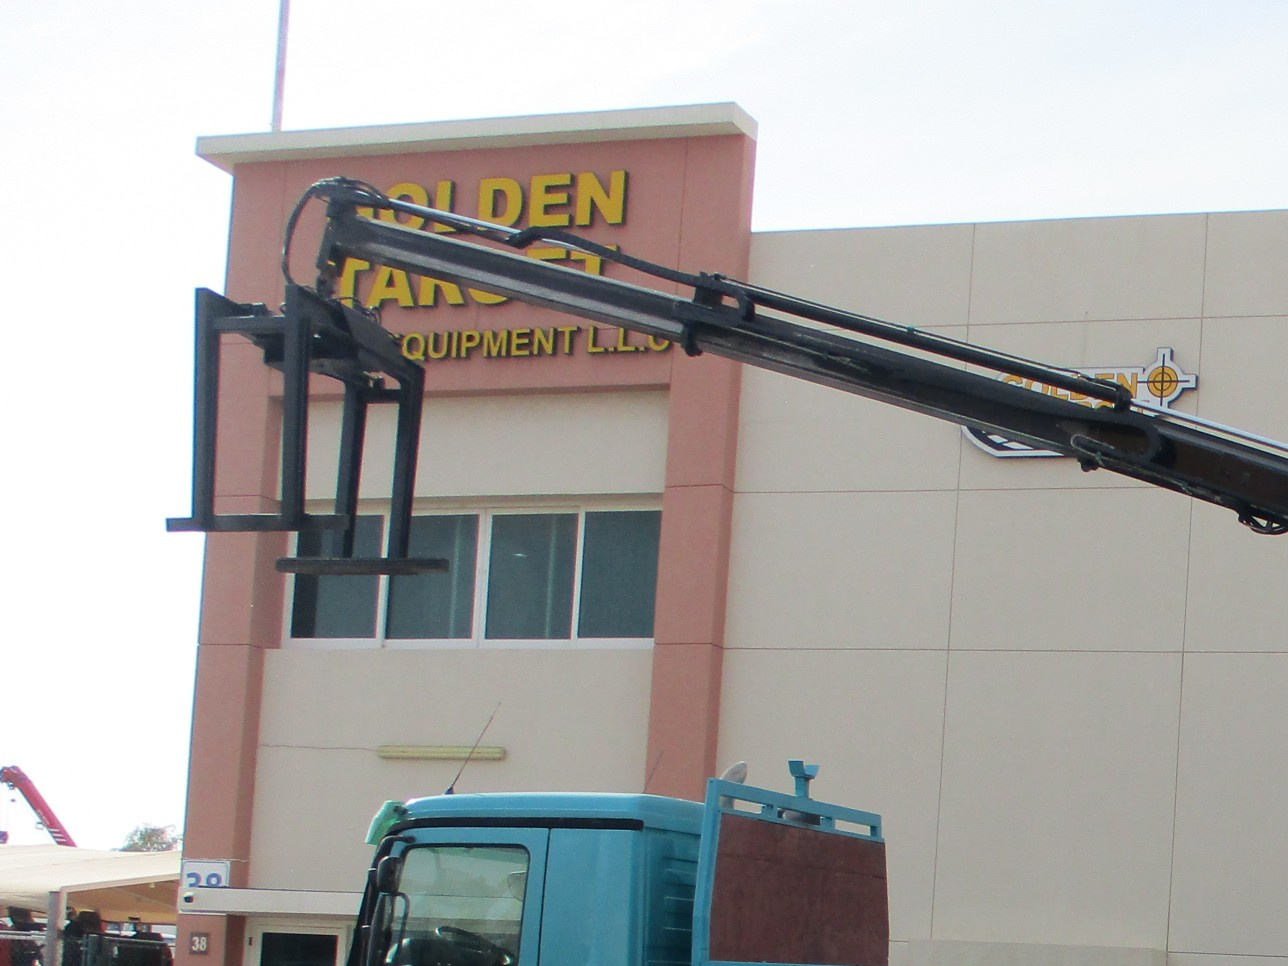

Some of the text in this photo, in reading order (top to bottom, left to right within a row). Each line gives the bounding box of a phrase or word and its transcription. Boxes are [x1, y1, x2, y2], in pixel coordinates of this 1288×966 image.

[356, 169, 627, 234] OLDEN
[393, 325, 578, 361] QUIPMENT
[192, 936, 207, 951] 38
